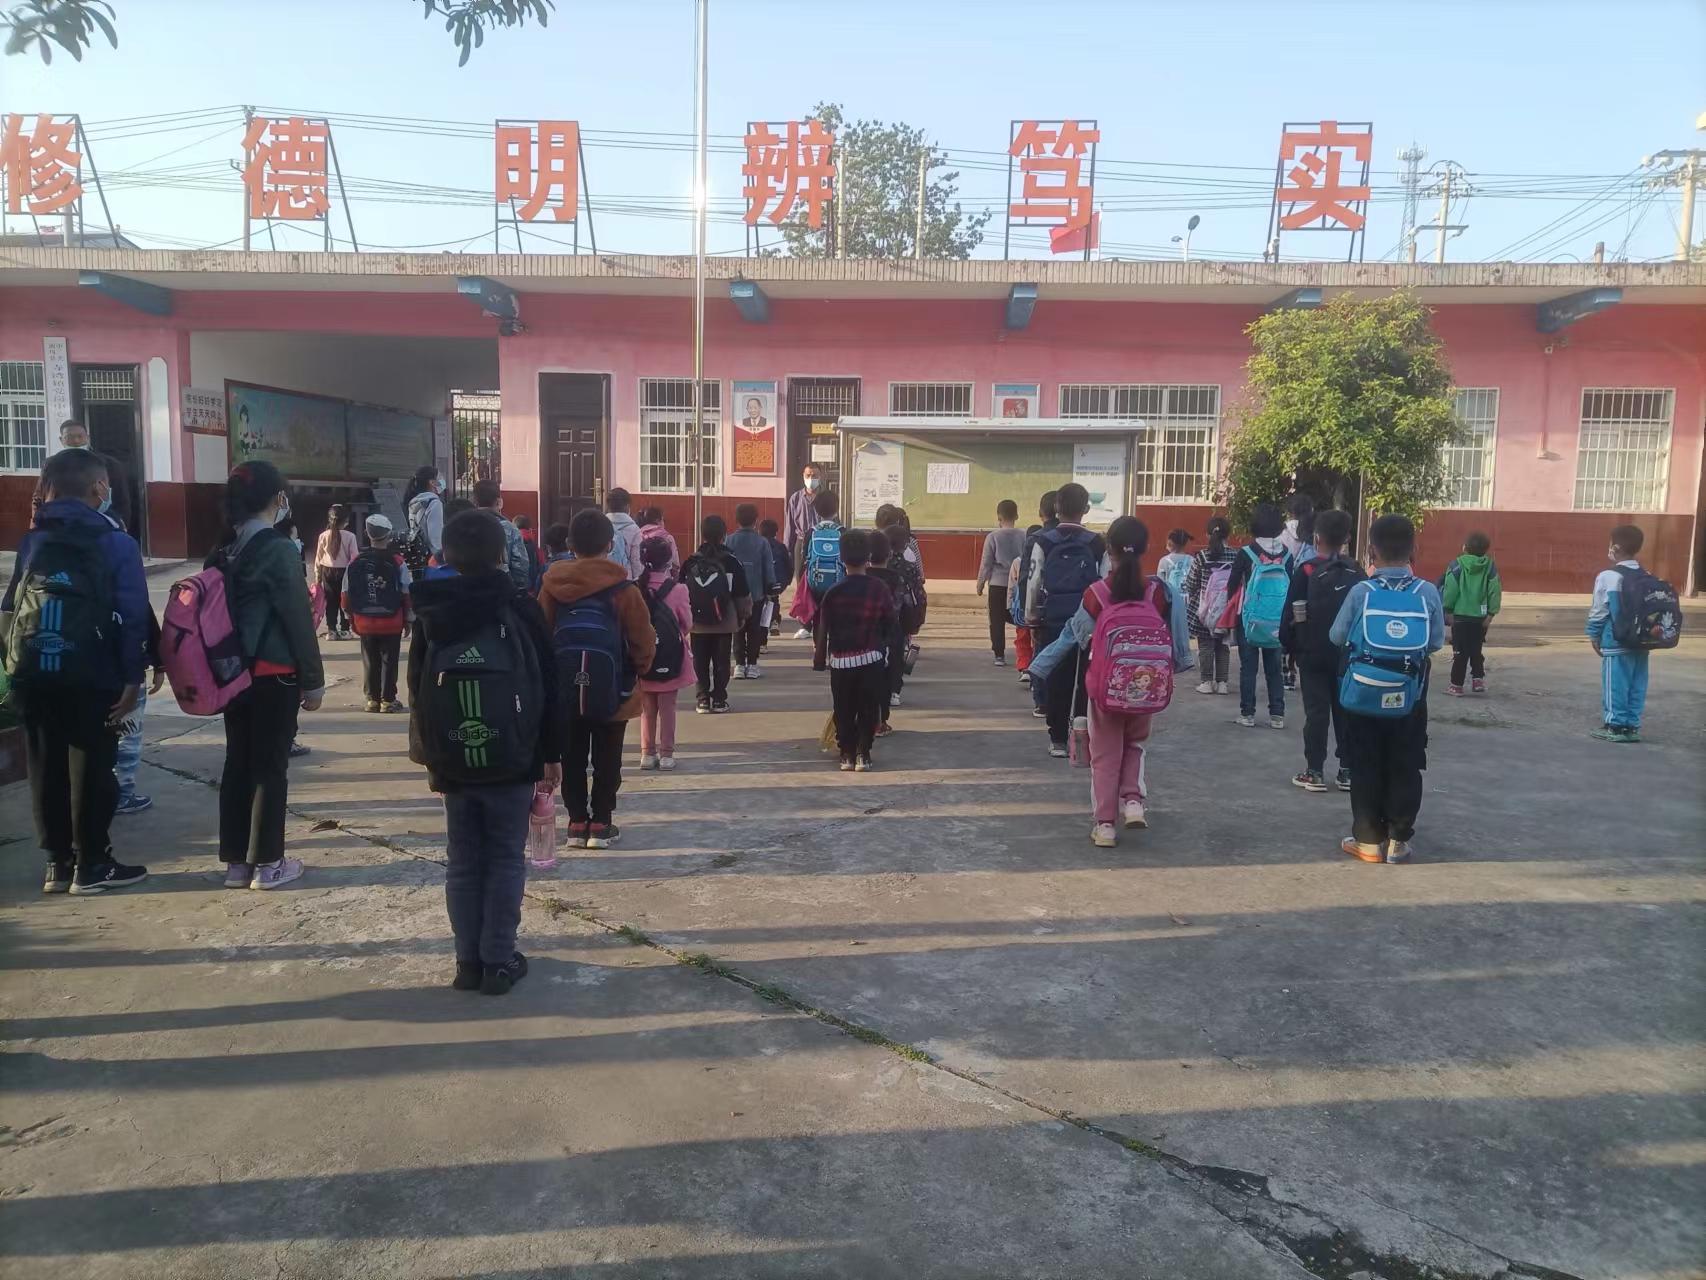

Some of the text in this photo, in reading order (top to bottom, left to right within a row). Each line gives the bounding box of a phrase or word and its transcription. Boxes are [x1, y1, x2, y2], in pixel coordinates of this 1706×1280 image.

[0, 112, 1372, 230] 修 德 明 辨 笃 实
[456, 656, 485, 664] adidas
